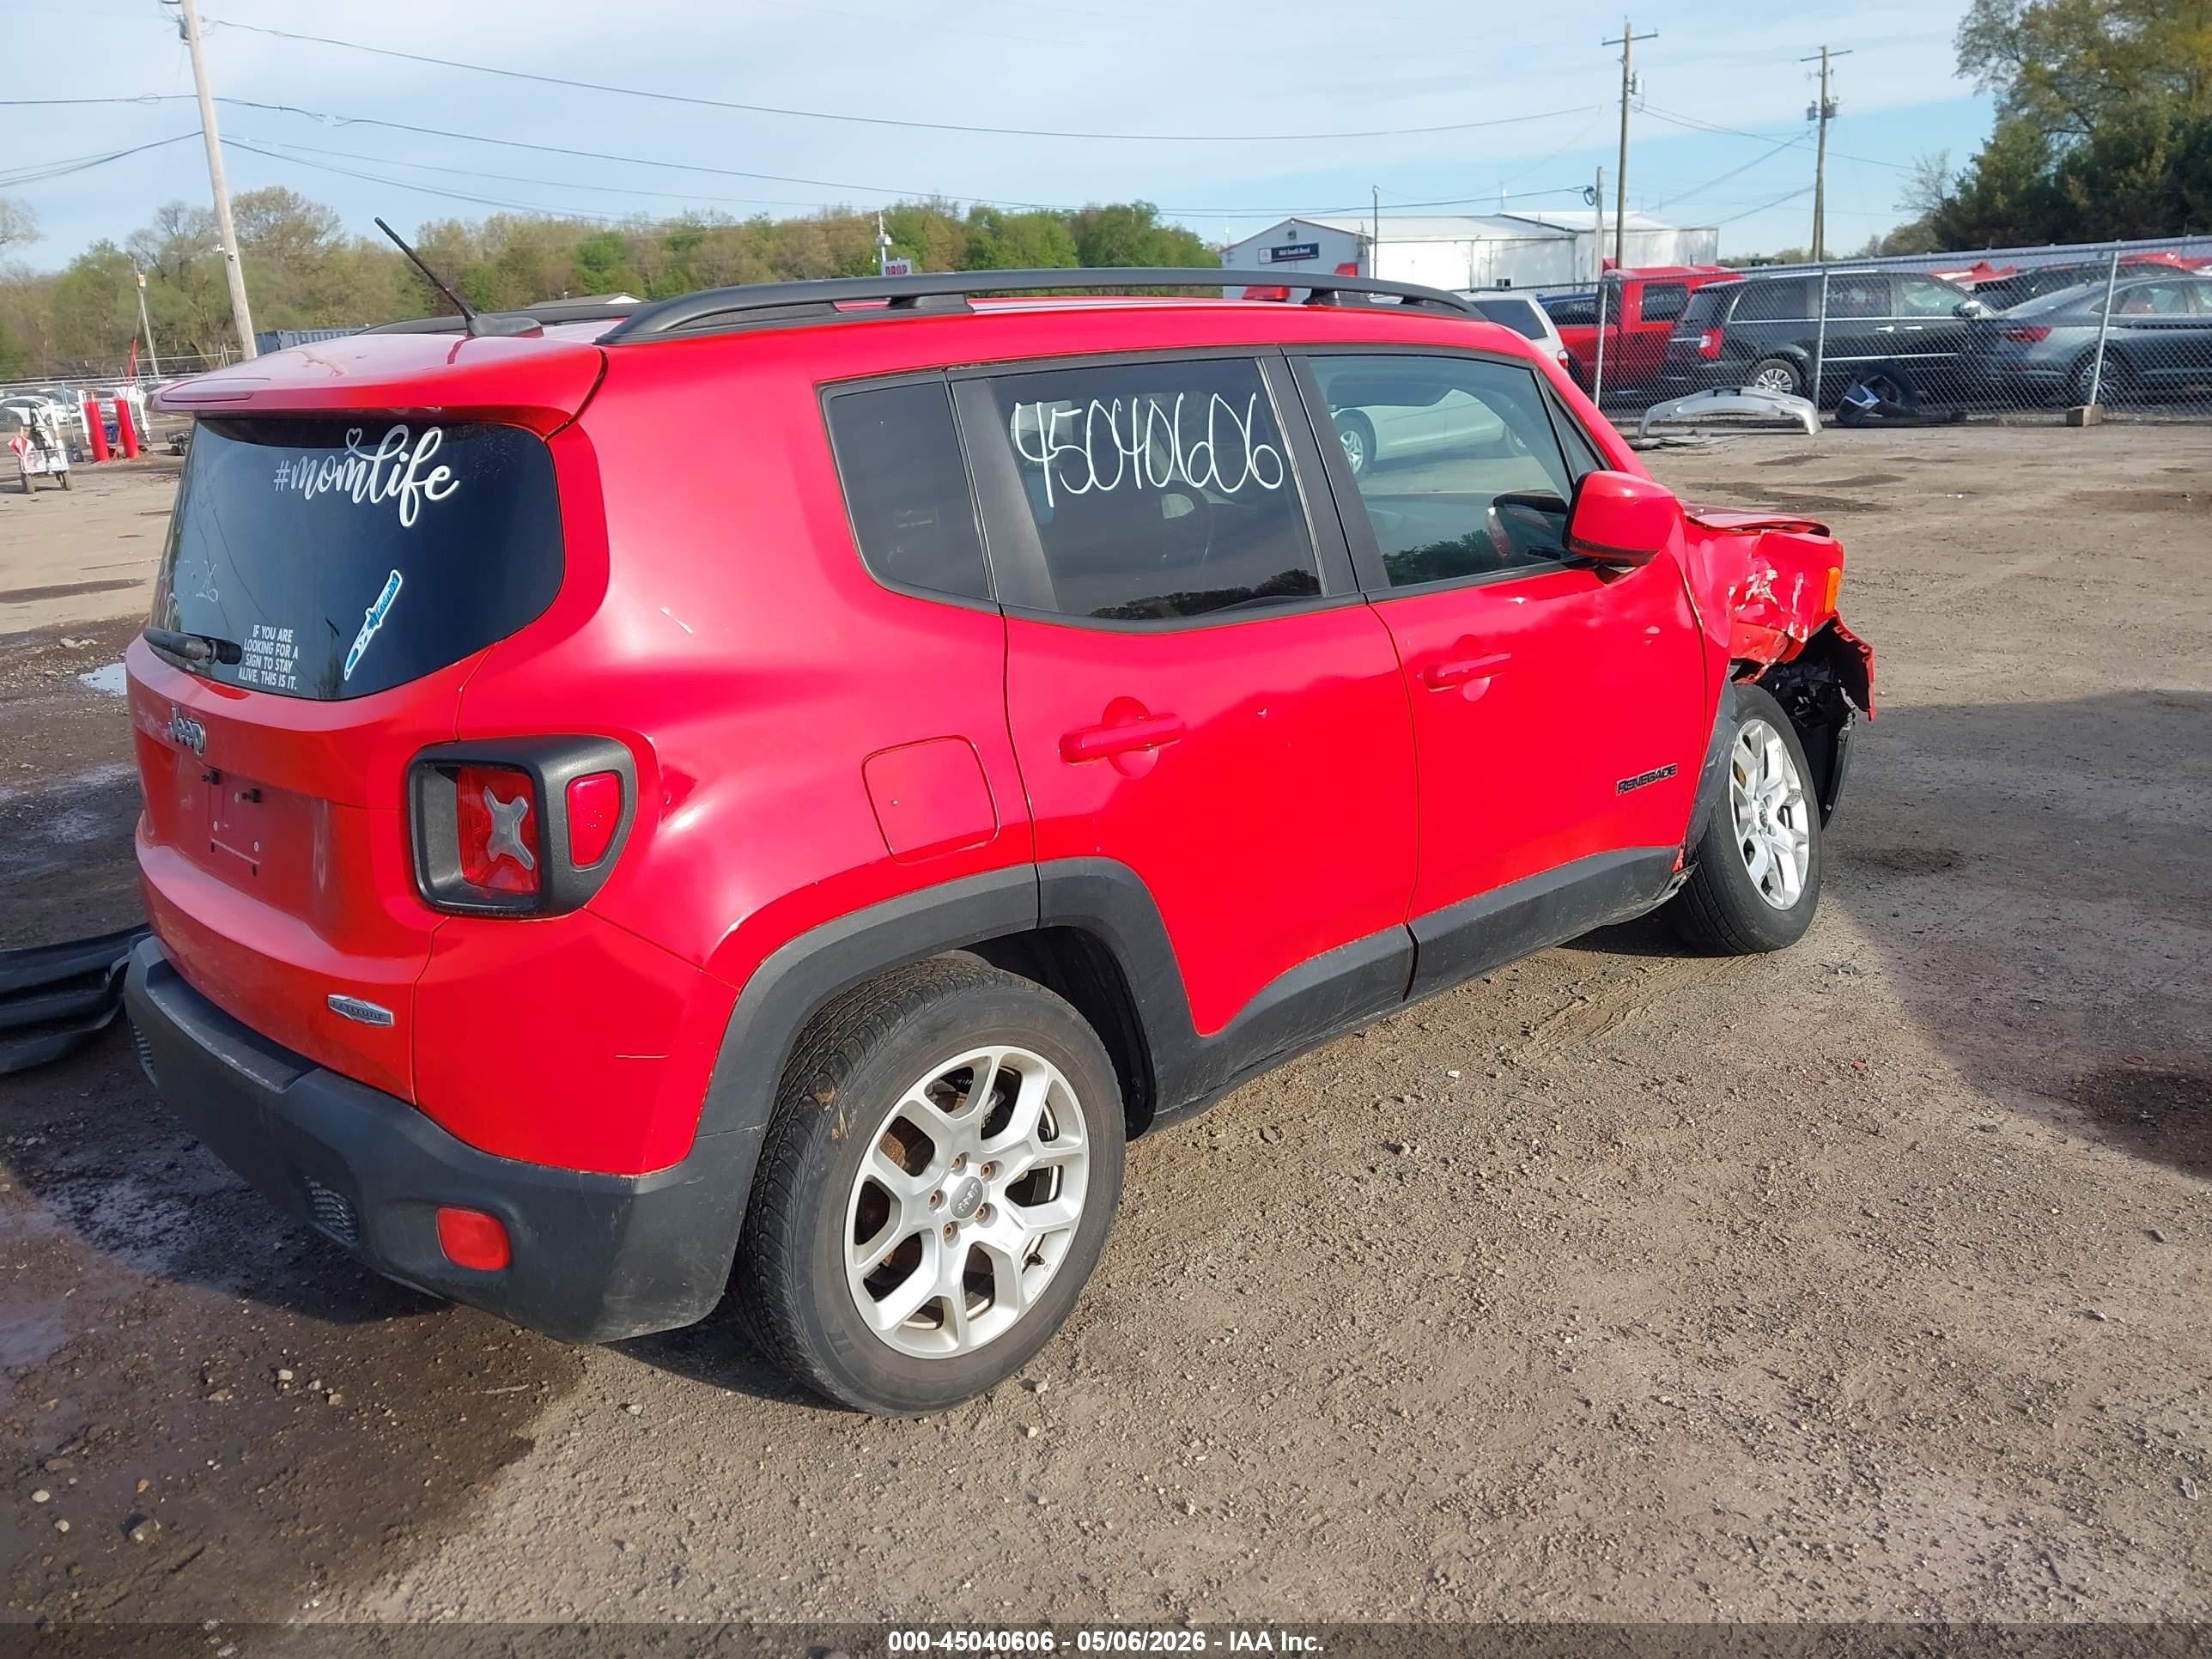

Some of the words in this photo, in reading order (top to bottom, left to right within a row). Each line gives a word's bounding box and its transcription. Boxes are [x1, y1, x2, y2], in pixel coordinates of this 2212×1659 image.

[1015, 392, 1284, 508] 45040606
[273, 424, 460, 528] #momlife
[252, 624, 259, 637] IF
[261, 625, 276, 640] YOU
[276, 628, 293, 643] ARE
[244, 638, 274, 655] LOOKING
[275, 643, 291, 658] FOR
[292, 645, 299, 659] A
[245, 653, 262, 669] SIGN
[263, 656, 274, 670] TO
[275, 658, 294, 674] STAY
[238, 666, 258, 684] ALIVE,
[260, 670, 276, 686] THIS
[278, 674, 286, 687] IS
[287, 676, 297, 690] IT.
[167, 705, 205, 757] Jeep
[1616, 763, 1678, 796] RENEGADE
[330, 998, 387, 1022] LATITUDE
